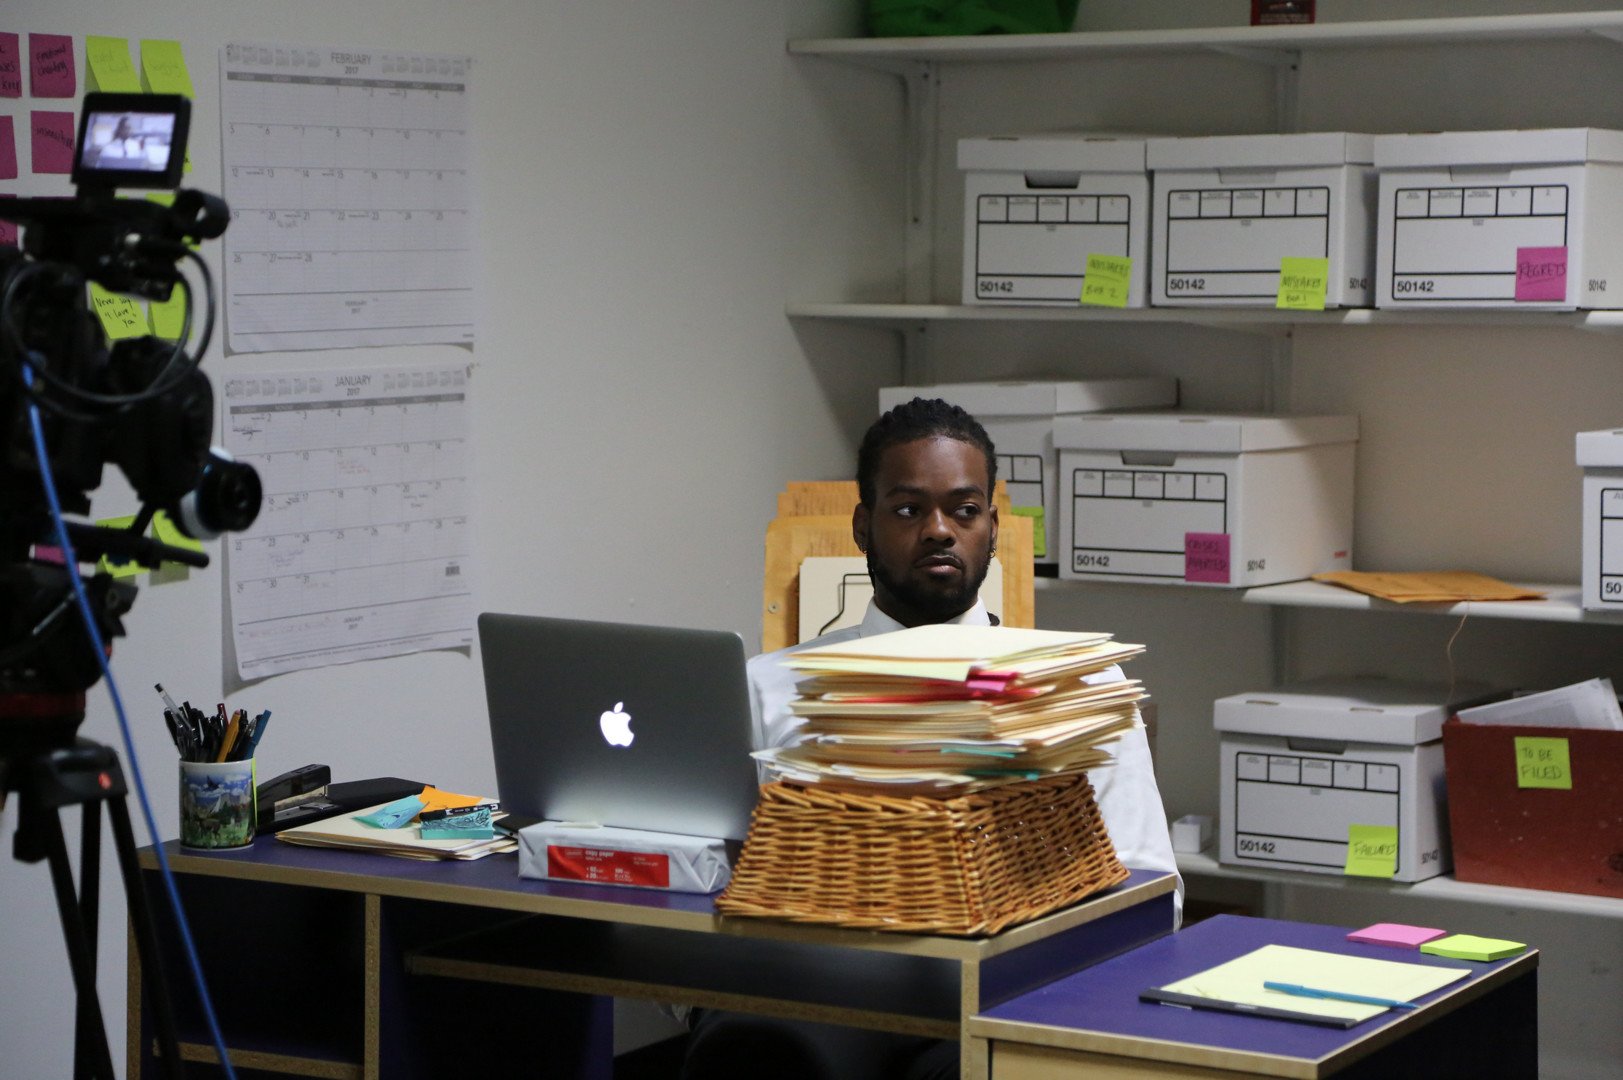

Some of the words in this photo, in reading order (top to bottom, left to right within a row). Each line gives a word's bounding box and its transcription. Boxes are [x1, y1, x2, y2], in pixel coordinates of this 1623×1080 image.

[331, 52, 371, 65] FEBRUARY
[345, 65, 359, 74] 2017
[1519, 262, 1566, 281] REGRETS
[980, 281, 1014, 293] 50142
[1169, 279, 1205, 291] 50142
[1397, 280, 1434, 293] 50142
[1588, 279, 1607, 292] 50142
[1110, 287, 1119, 299] 2
[335, 375, 371, 387] JANUARY
[347, 387, 360, 396] 2017
[1076, 555, 1110, 567] 50142
[1605, 582, 1623, 594] 50
[1521, 764, 1562, 779] FILED
[1239, 840, 1276, 854] 50142
